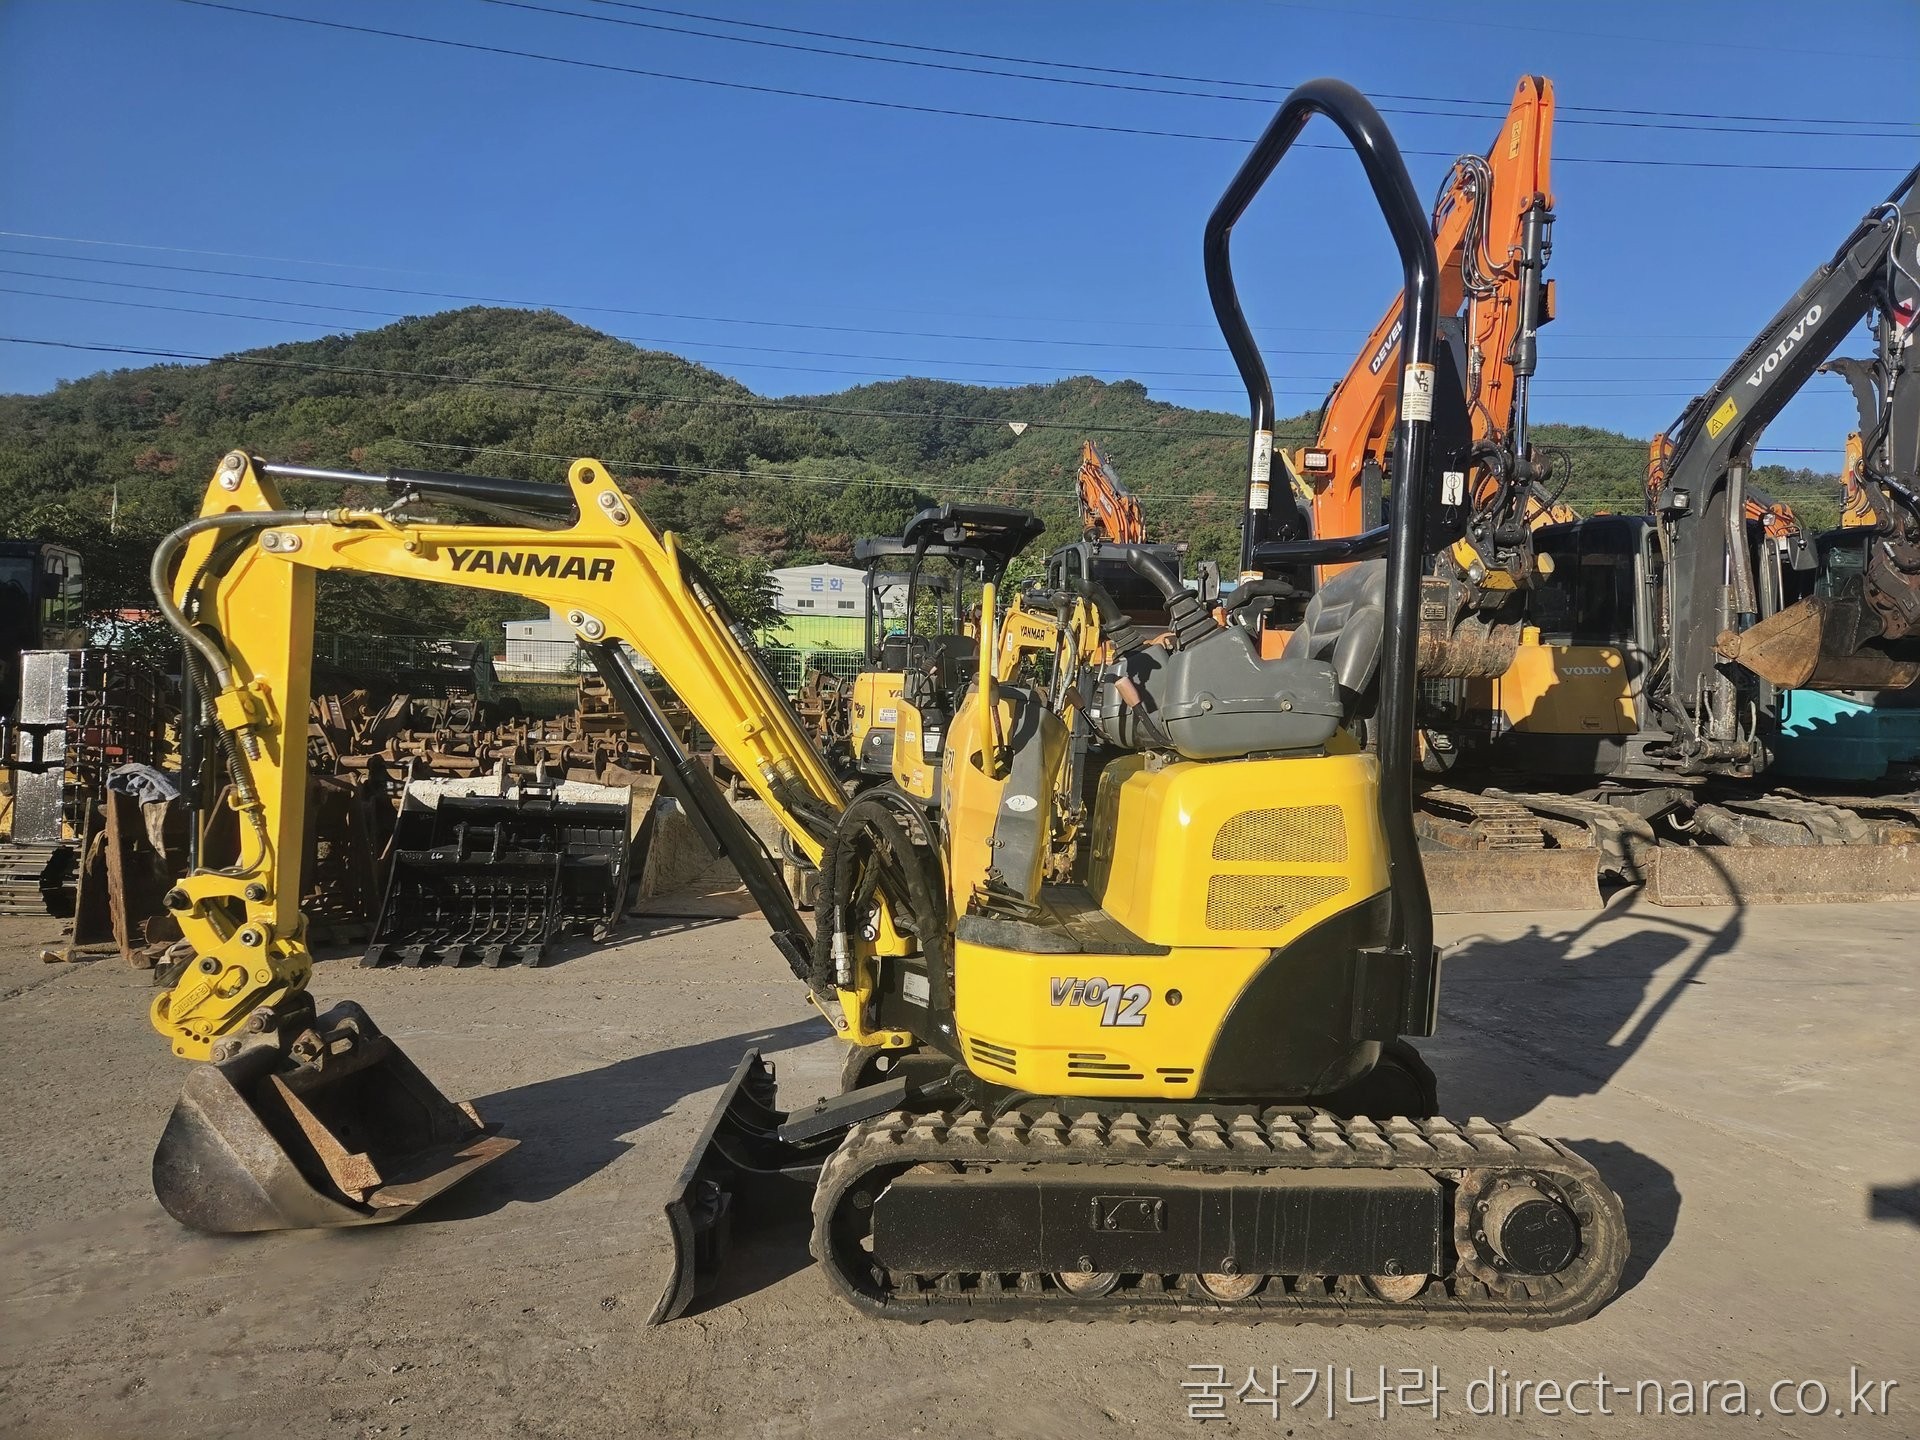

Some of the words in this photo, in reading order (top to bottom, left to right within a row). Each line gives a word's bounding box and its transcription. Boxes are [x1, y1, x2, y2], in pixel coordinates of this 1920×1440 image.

[1745, 304, 1822, 387] VOLVO
[447, 547, 616, 582] YANMAR
[810, 577, 844, 592] 문화
[1020, 625, 1046, 642] YANMAR
[1561, 666, 1612, 675] VOLVO
